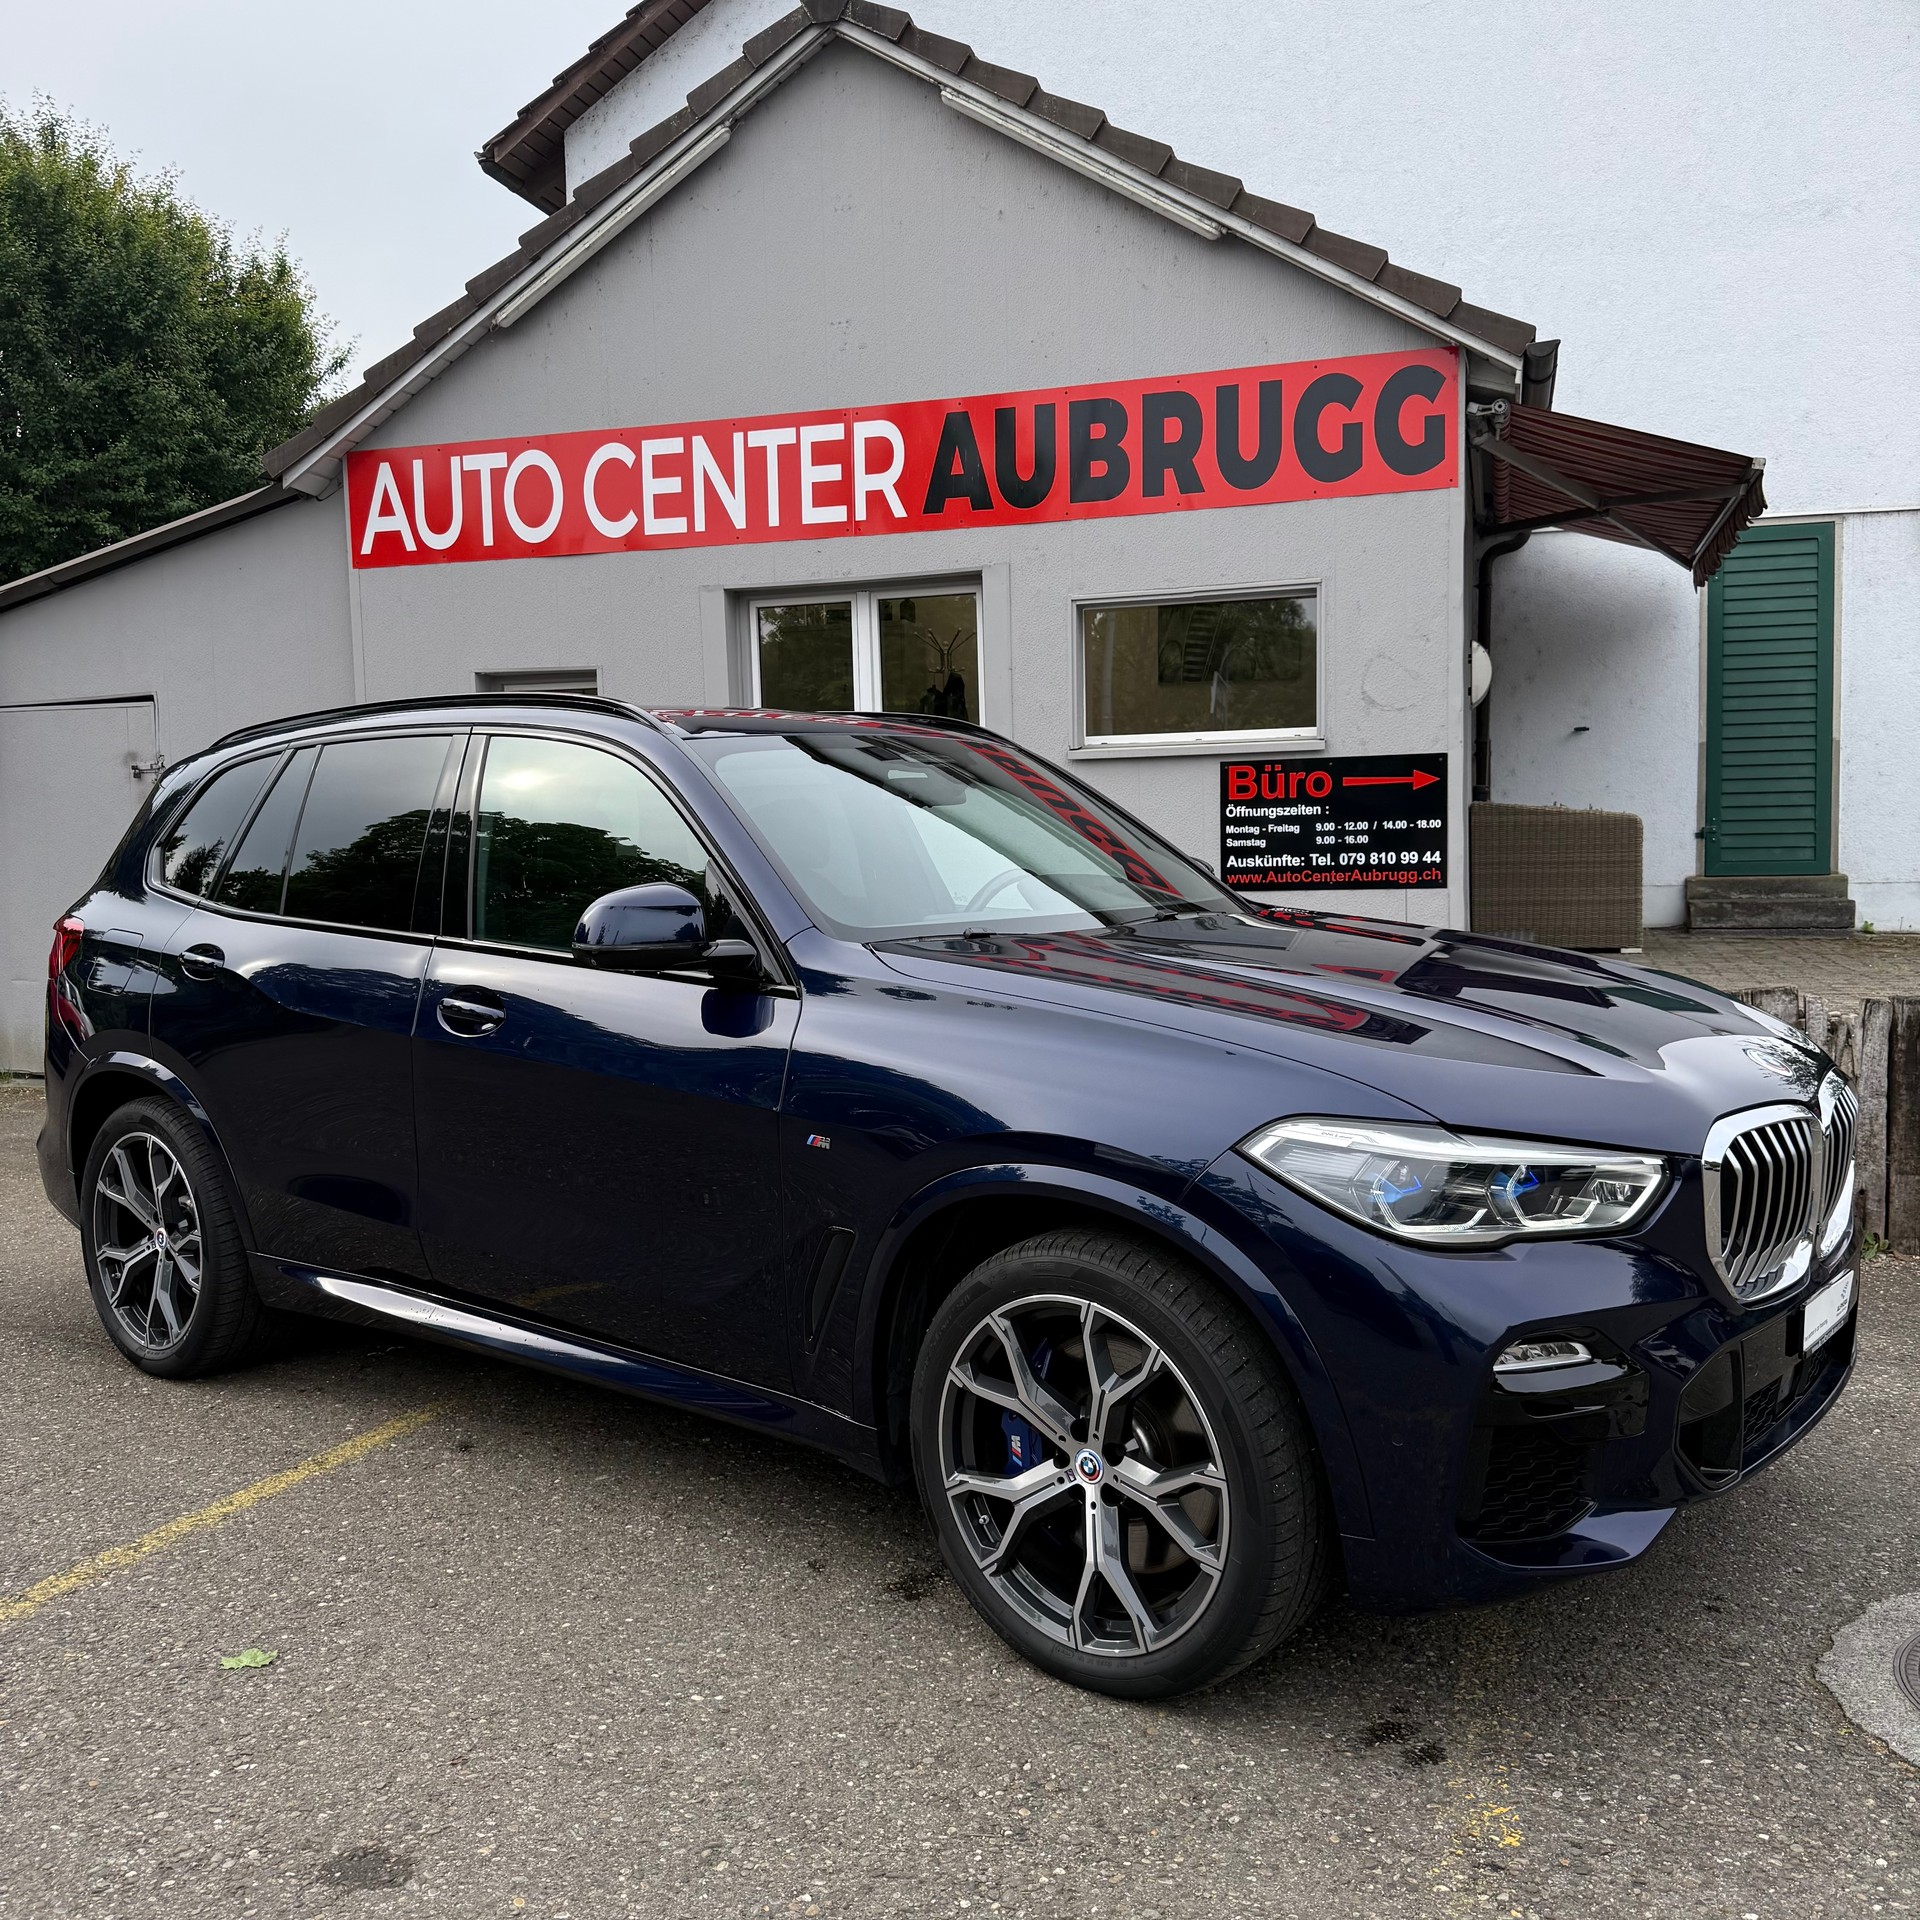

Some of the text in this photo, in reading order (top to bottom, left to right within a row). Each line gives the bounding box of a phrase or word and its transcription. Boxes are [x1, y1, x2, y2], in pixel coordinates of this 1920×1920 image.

[360, 363, 1448, 556] AUTO CENTER AUBRUGG
[1228, 764, 1333, 801] Büro
[1225, 803, 1322, 819] Öffnungszeiten
[1225, 825, 1260, 836] Montag
[1267, 823, 1300, 834] Freitag
[1315, 822, 1336, 832] 9.00
[1343, 821, 1369, 831] 12.00
[1382, 820, 1408, 830] 14.00
[1415, 819, 1442, 829] 18.00
[1226, 838, 1267, 849] Samstag
[1315, 835, 1336, 845] 9.00
[1343, 834, 1369, 844] 16.00
[1226, 850, 1442, 868] Auskünfte: Tel. 079 810 99 44
[1227, 867, 1442, 885] www.AutoCenterAubrugg.ch
